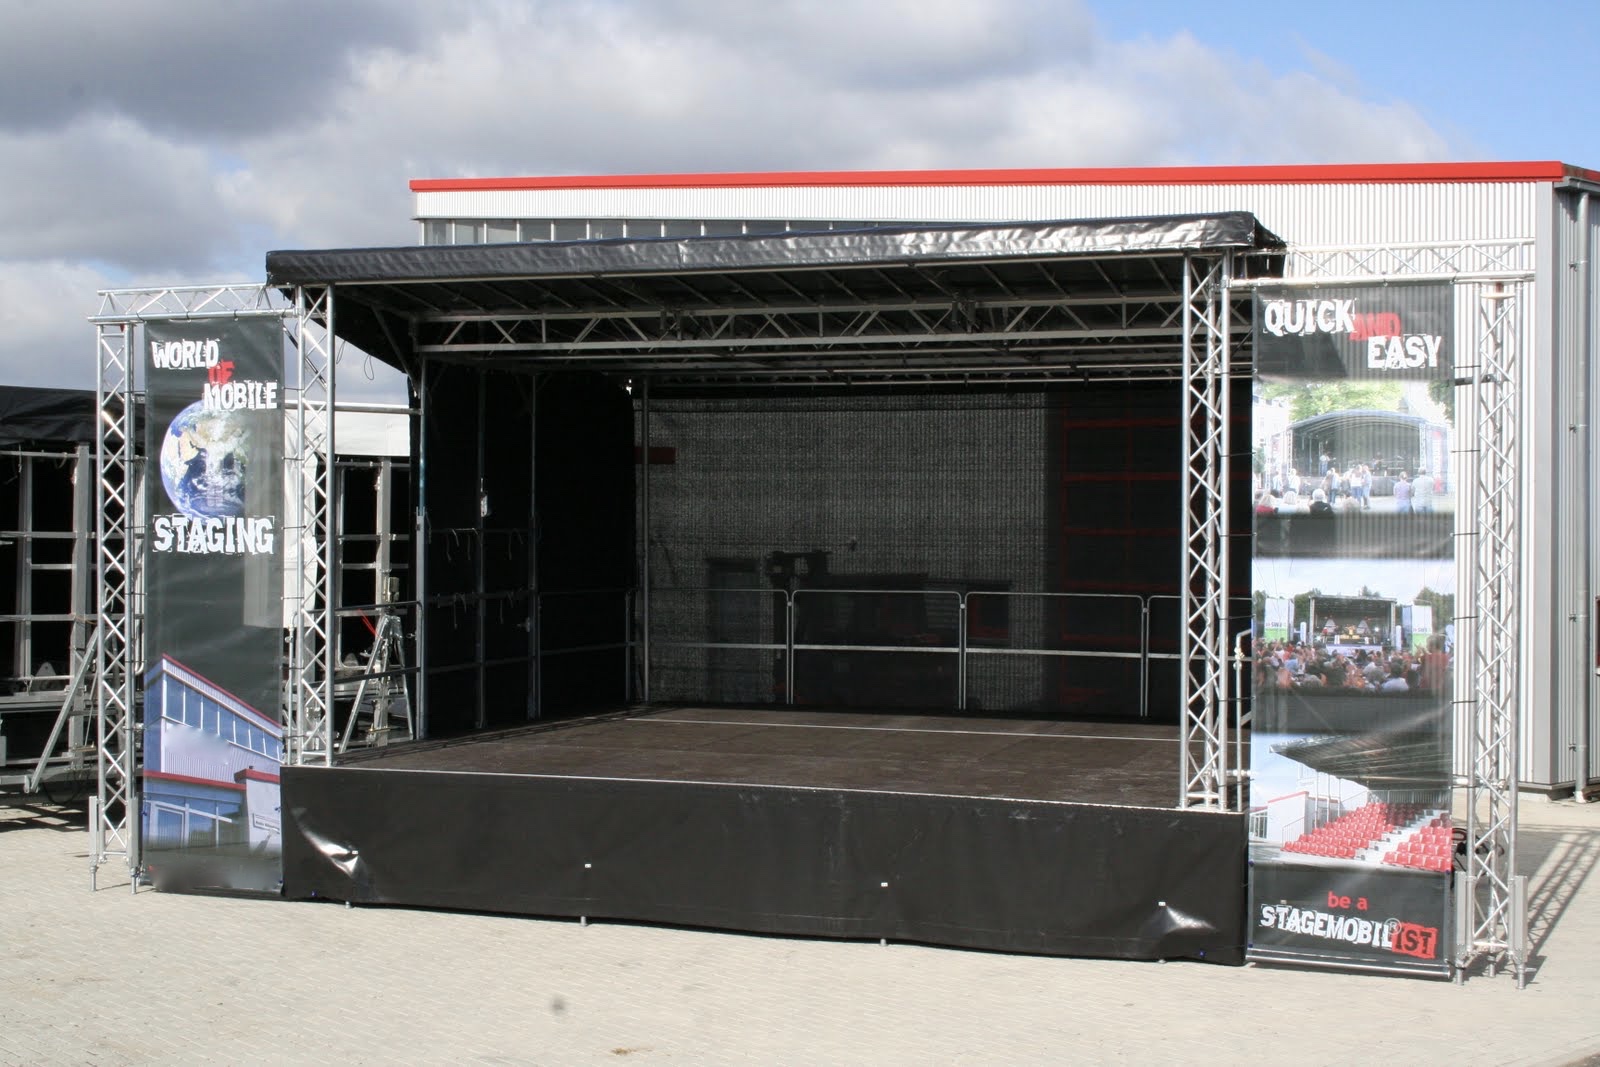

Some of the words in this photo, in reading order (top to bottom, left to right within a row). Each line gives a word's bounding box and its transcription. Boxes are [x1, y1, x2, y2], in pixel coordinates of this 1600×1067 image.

[1264, 299, 1357, 336] QUICK
[1350, 312, 1402, 341] AND
[151, 339, 219, 369] WORLD
[1367, 334, 1441, 370] EASY
[208, 359, 235, 384] OF
[203, 381, 278, 411] MOBILE
[153, 515, 275, 554] STAGING
[1328, 891, 1351, 909] be
[1357, 897, 1368, 910] a
